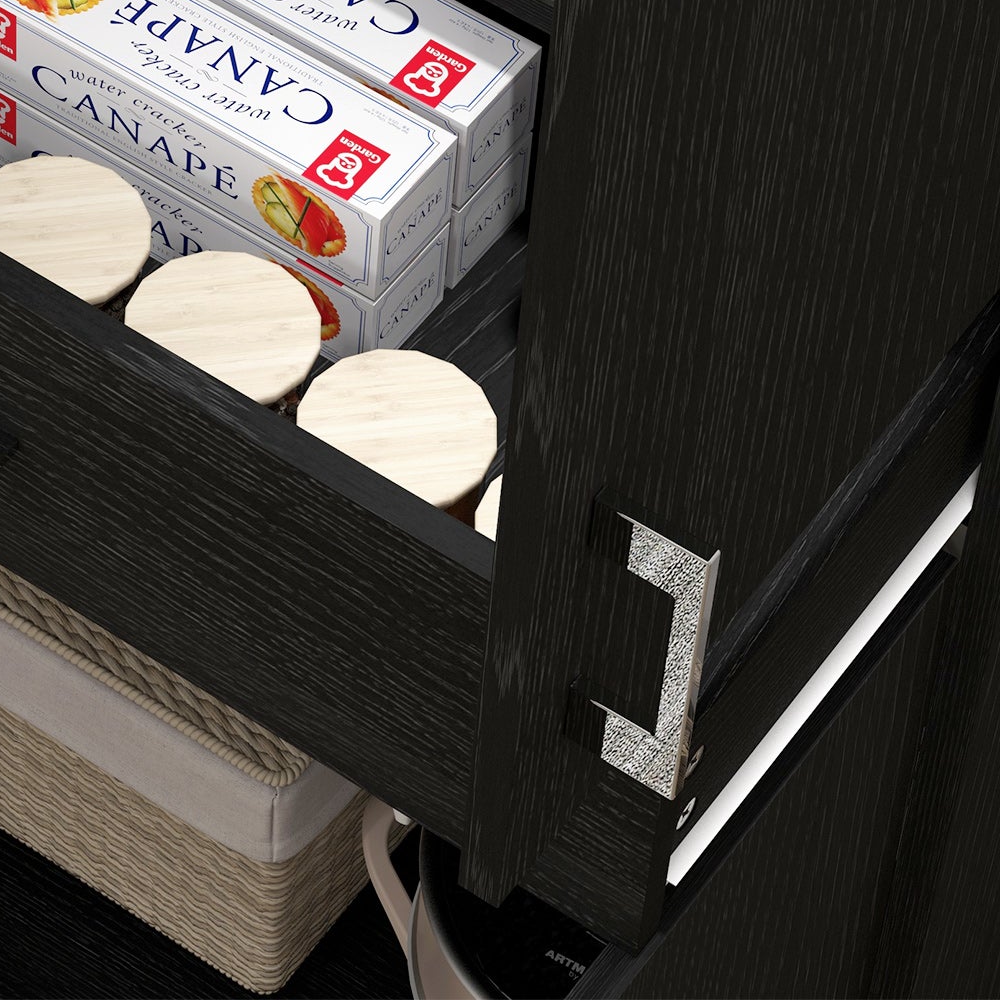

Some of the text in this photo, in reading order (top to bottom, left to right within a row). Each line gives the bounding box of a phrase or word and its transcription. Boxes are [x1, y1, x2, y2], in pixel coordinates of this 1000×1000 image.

[203, 16, 228, 33] STYLE
[289, 2, 359, 32] water
[229, 31, 265, 54] ENGLISH
[267, 52, 323, 86] TRADITIONAL
[425, 45, 468, 74] Garden
[130, 40, 272, 121] water cracker
[69, 68, 207, 150] water cracker
[31, 65, 239, 200] CANAPÉ
[55, 104, 214, 197] TRADITIONAL ENGLISH STYLE CRACKER
[339, 136, 383, 165] Garden
[544, 949, 587, 975] ARTM
